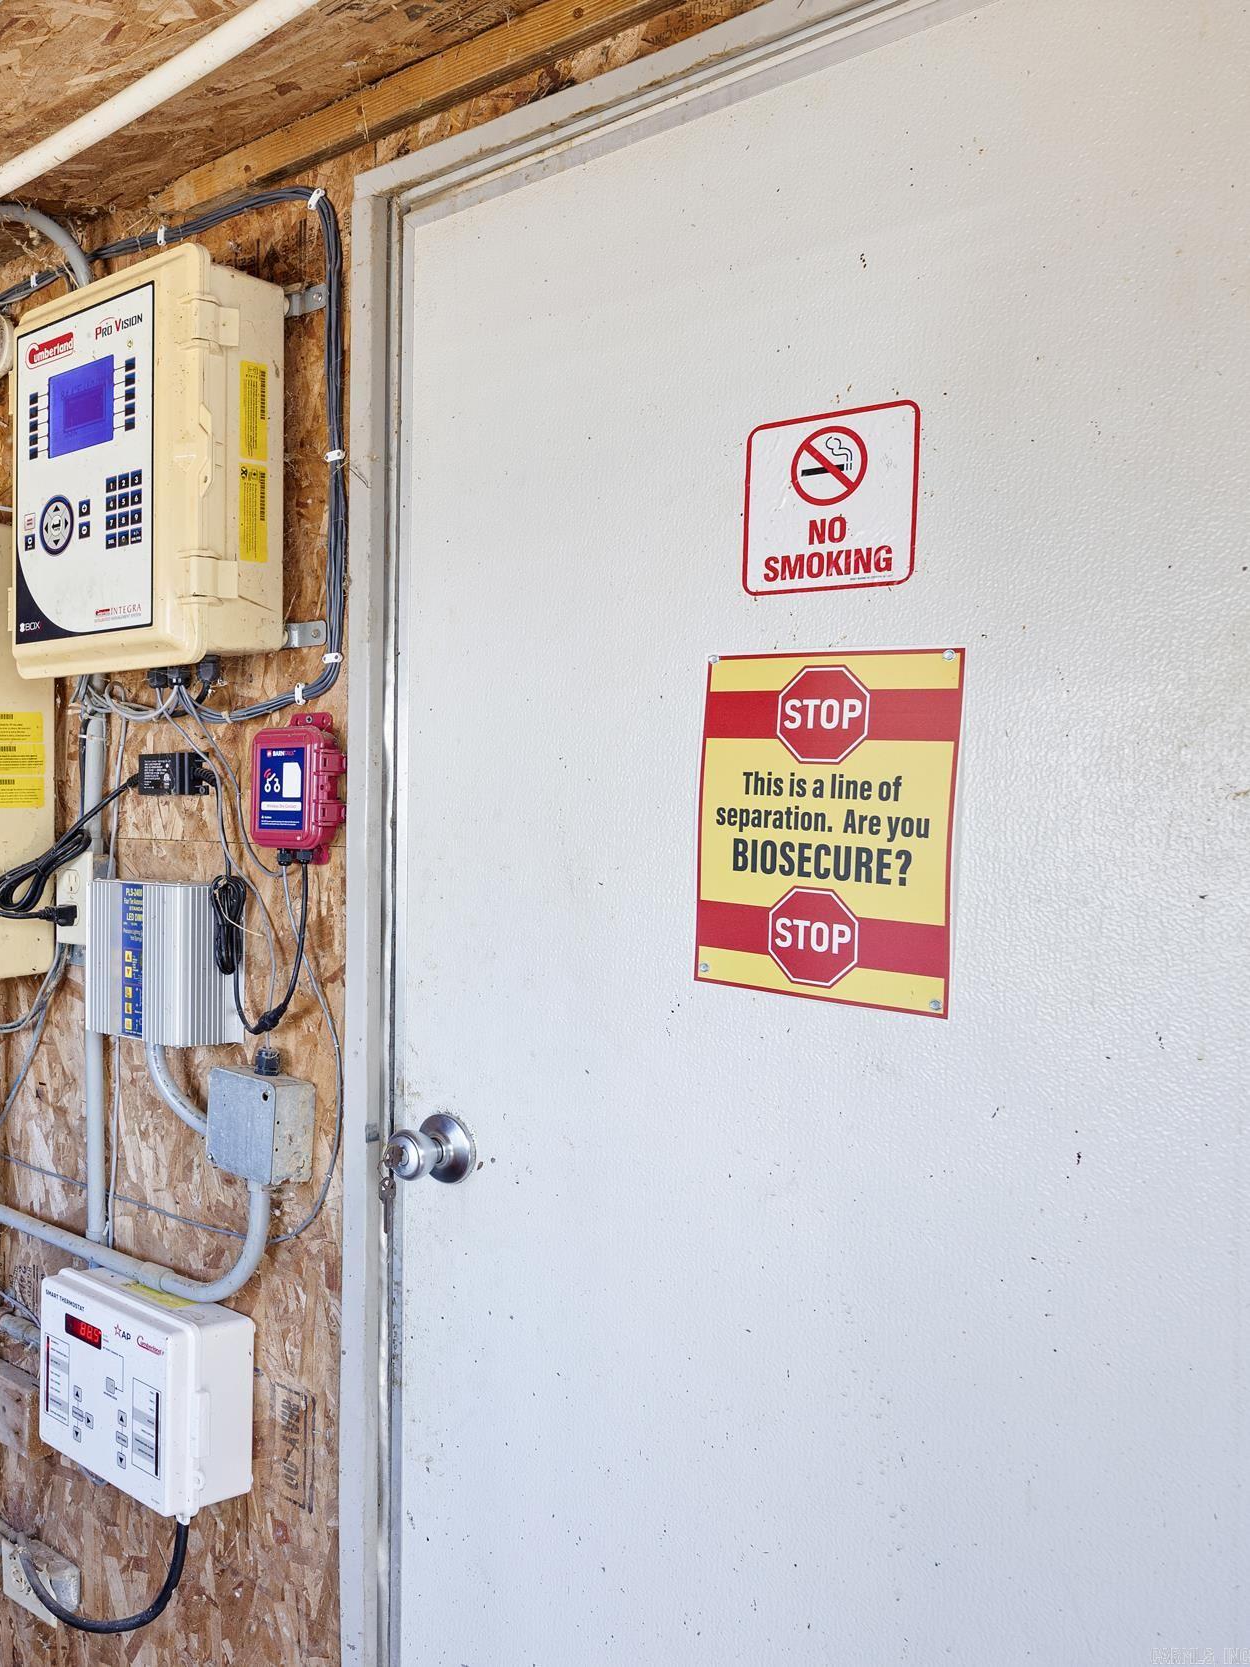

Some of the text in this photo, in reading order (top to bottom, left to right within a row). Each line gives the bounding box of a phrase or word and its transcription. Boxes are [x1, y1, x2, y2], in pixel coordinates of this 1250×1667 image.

[95, 313, 142, 340] PRO VISION
[26, 335, 75, 369] Cumberland
[808, 516, 847, 545] NO
[764, 545, 892, 582] SMOKING
[110, 604, 142, 616] INTEGRA
[784, 698, 862, 730] STOP
[743, 771, 902, 802] This is a line of
[716, 806, 930, 842] separation. Are you
[732, 838, 913, 886] BIOSECURE?
[775, 918, 852, 954] STOP
[46, 1289, 84, 1312] SMART THERMOSTAT
[122, 1331, 131, 1340] AP
